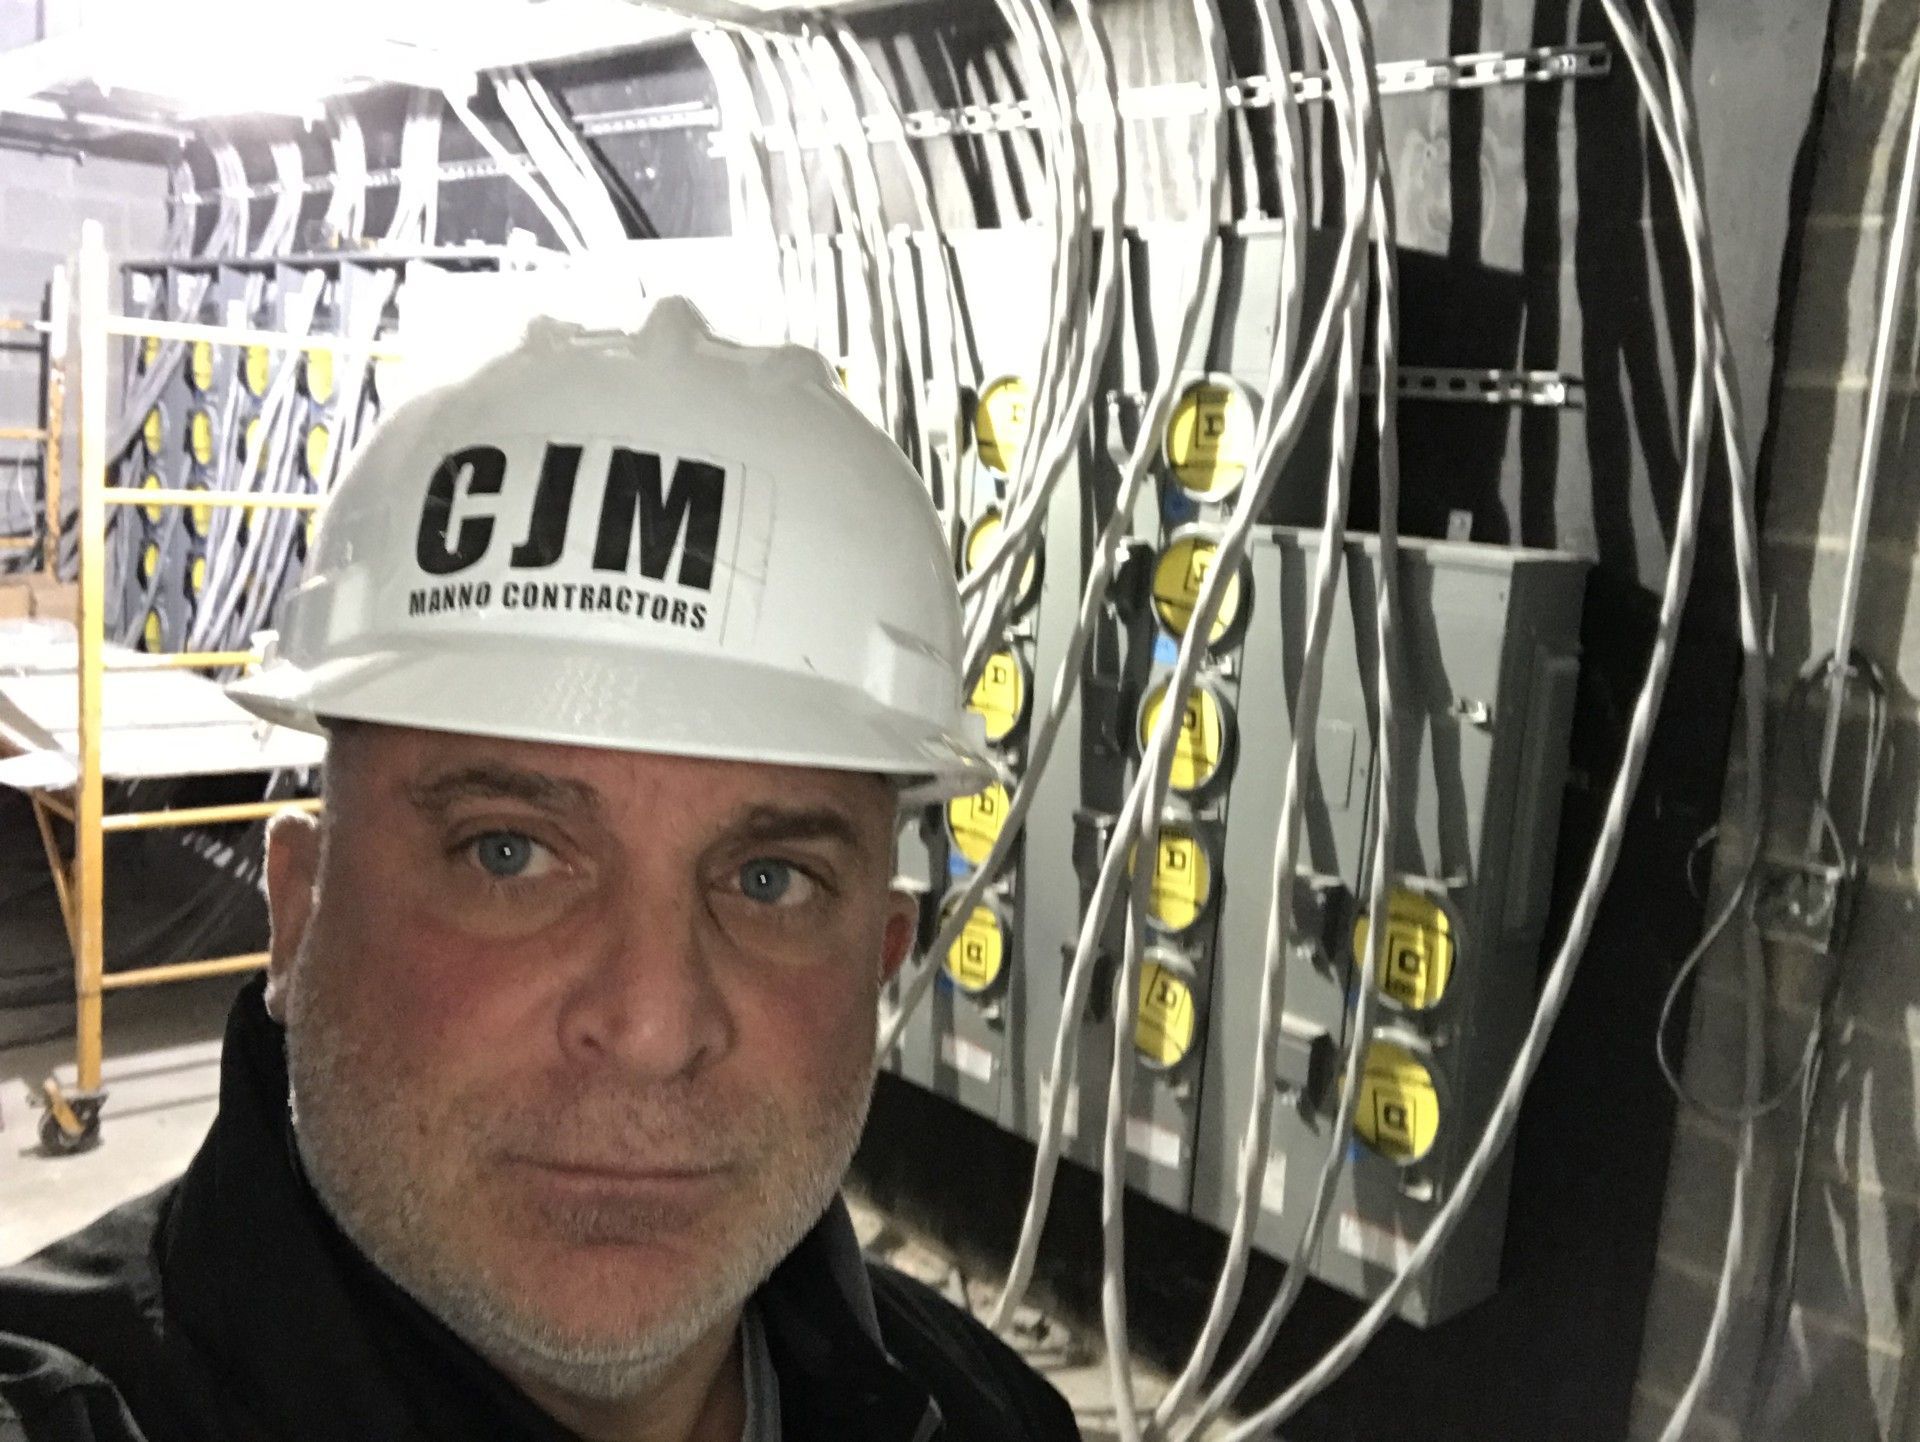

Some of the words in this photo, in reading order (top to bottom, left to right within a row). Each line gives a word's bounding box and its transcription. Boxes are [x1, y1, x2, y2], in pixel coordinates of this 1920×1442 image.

[416, 441, 726, 591] CJM
[408, 582, 492, 616] MANNO
[502, 582, 708, 632] CONTRACTORS
